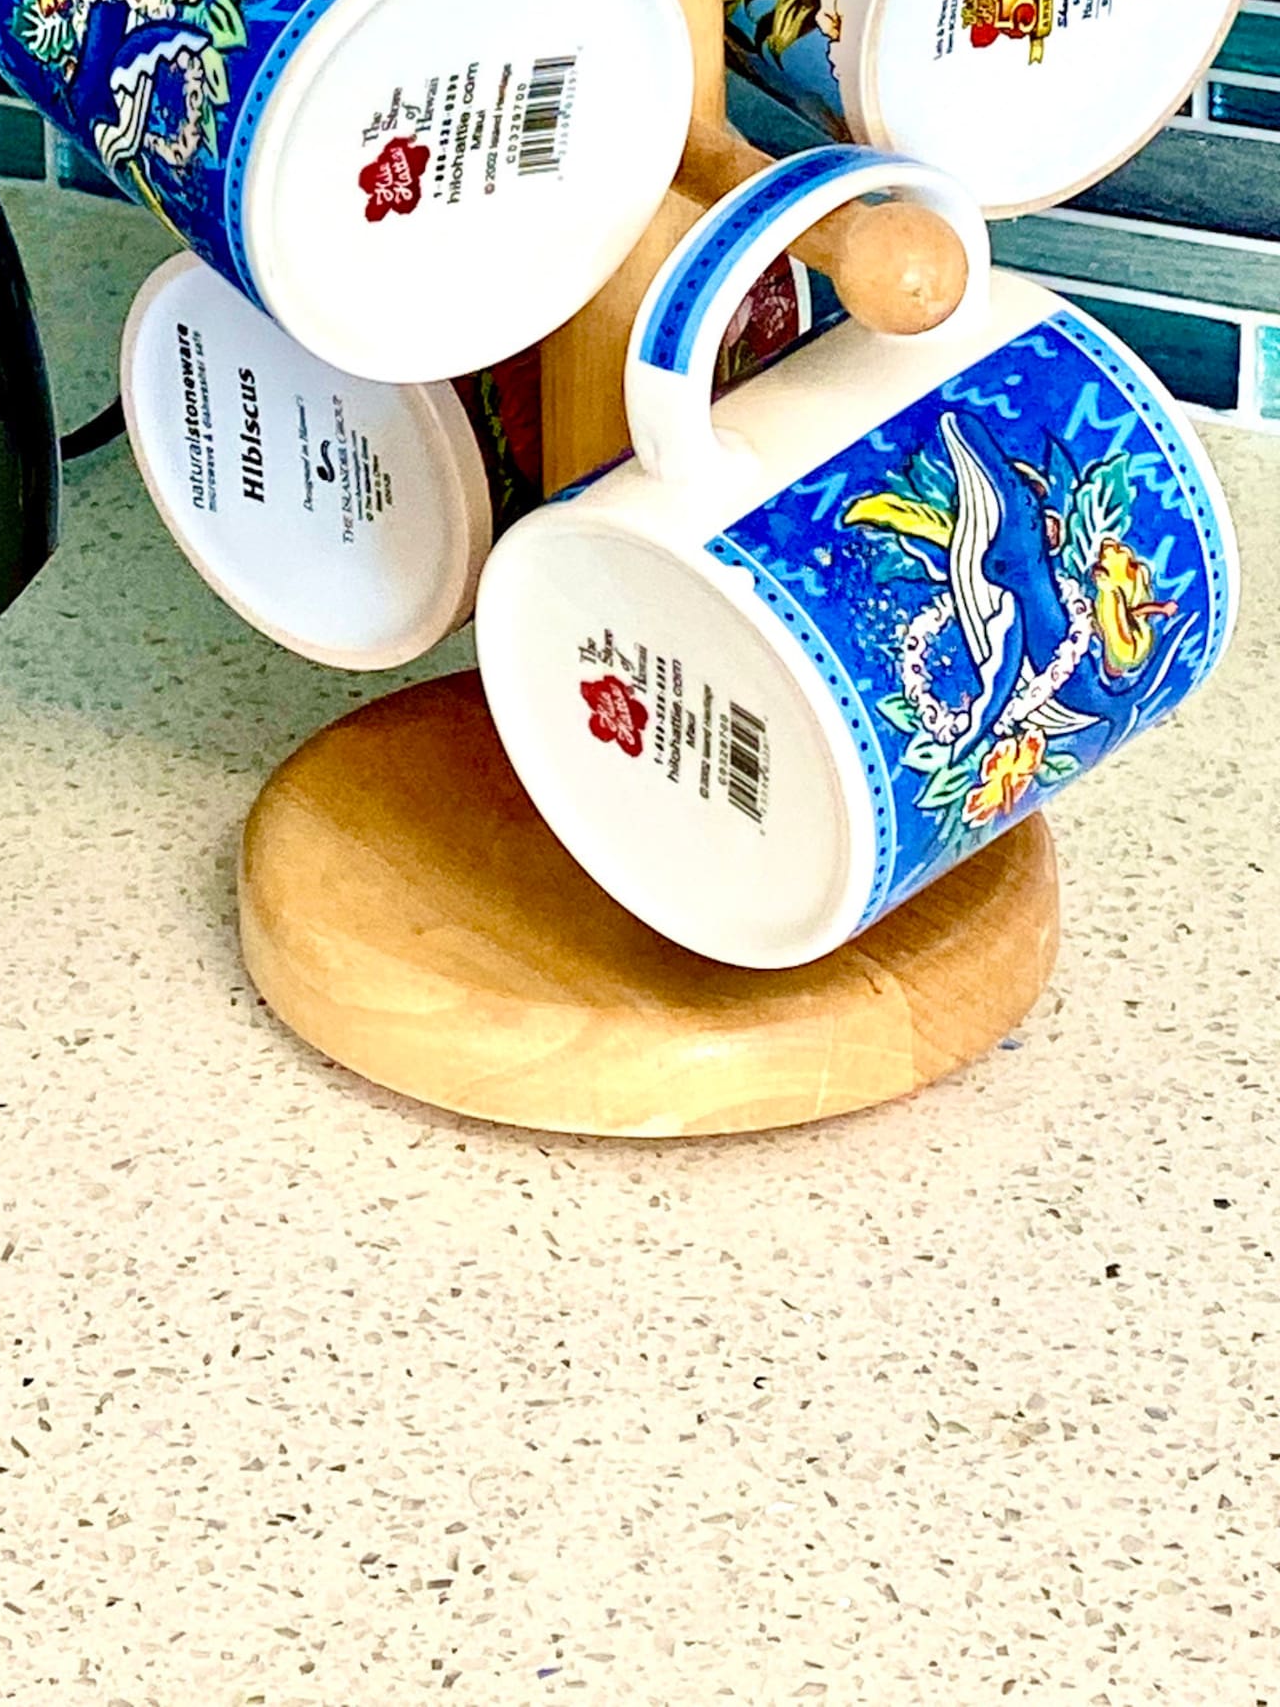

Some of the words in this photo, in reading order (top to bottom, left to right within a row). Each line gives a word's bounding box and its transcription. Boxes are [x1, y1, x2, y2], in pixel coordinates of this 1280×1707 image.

[381, 87, 402, 131] Store
[401, 102, 421, 120] of
[415, 77, 439, 133] Hawaii
[362, 112, 382, 147] The
[470, 109, 486, 150] Maui
[374, 162, 394, 205] Hilo
[192, 330, 204, 356] safe
[197, 361, 212, 429] dishwasher
[176, 323, 205, 509] naturalstoneware
[238, 367, 265, 504] Hibiscus
[206, 446, 218, 513] microwave
[342, 515, 354, 543] THE
[577, 637, 597, 665] The
[597, 629, 614, 667] Store
[614, 648, 635, 672] of
[685, 710, 696, 749] Maui
